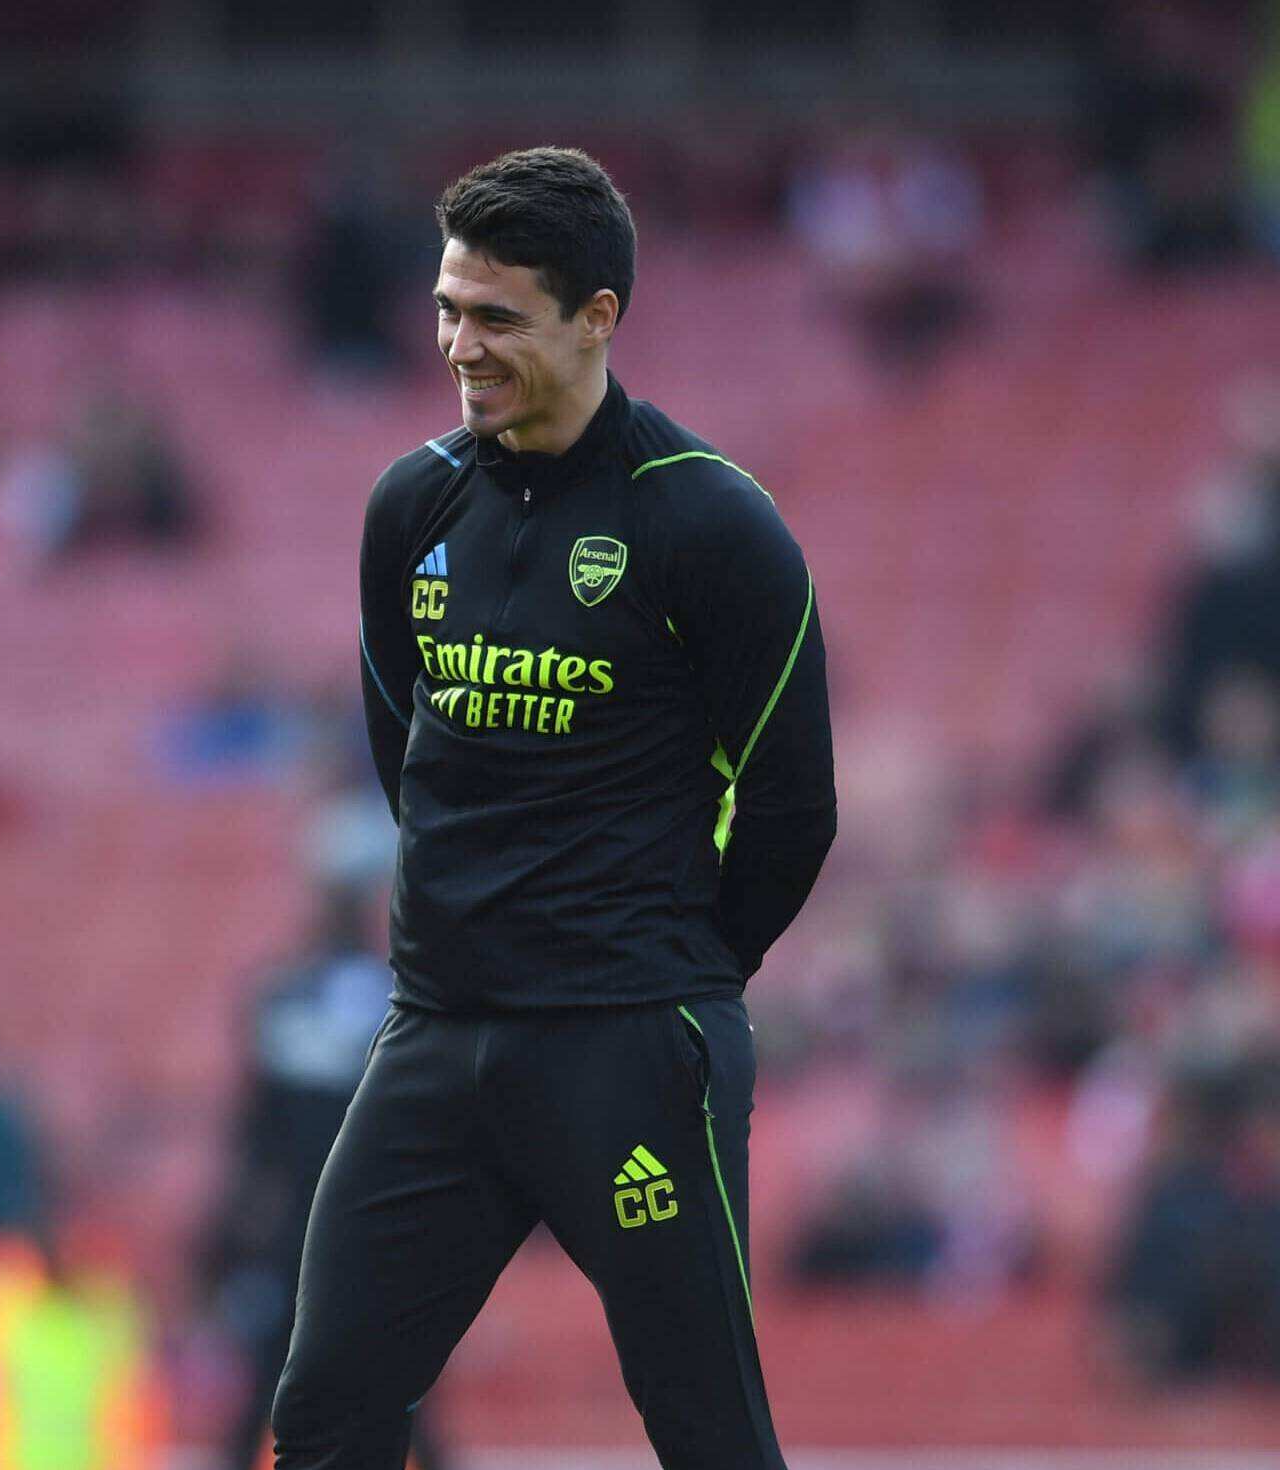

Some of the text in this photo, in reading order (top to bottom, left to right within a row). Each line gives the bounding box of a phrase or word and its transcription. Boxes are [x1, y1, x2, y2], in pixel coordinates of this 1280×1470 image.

[579, 547, 618, 562] Arsenal
[412, 579, 449, 619] CC
[416, 633, 614, 694] Emirates
[465, 690, 575, 734] BETTER
[614, 1179, 678, 1229] CC
